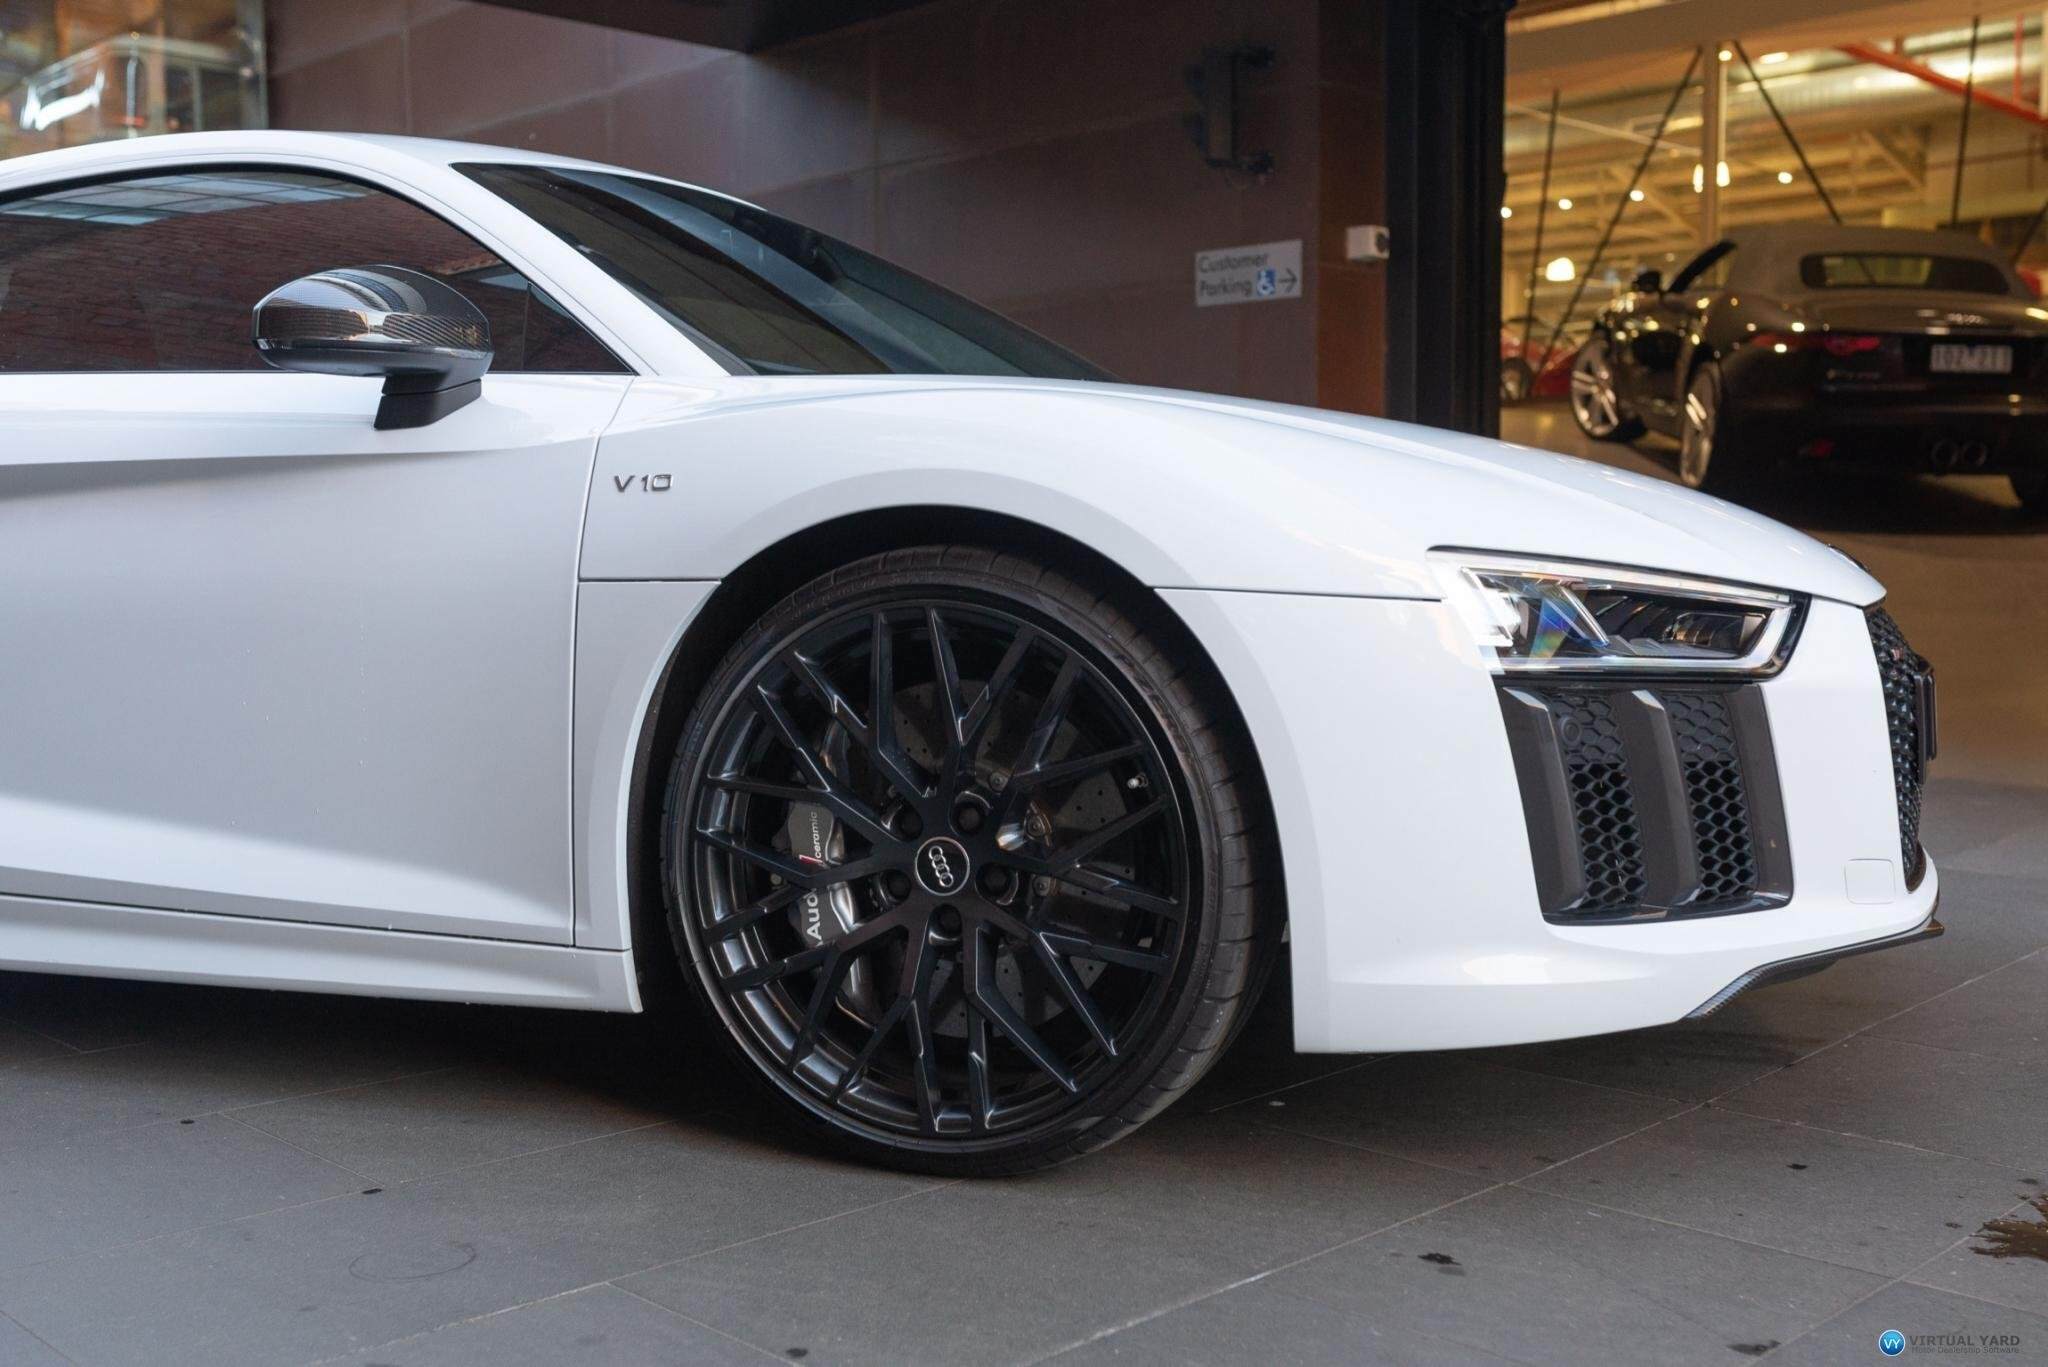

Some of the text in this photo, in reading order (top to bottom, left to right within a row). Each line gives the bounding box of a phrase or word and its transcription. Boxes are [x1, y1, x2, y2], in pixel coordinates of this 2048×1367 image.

[1199, 253, 1269, 273] Customer
[1200, 277, 1253, 298] Parking
[613, 474, 673, 493] V10
[810, 811, 823, 859] ceramic
[803, 887, 822, 941] Aud
